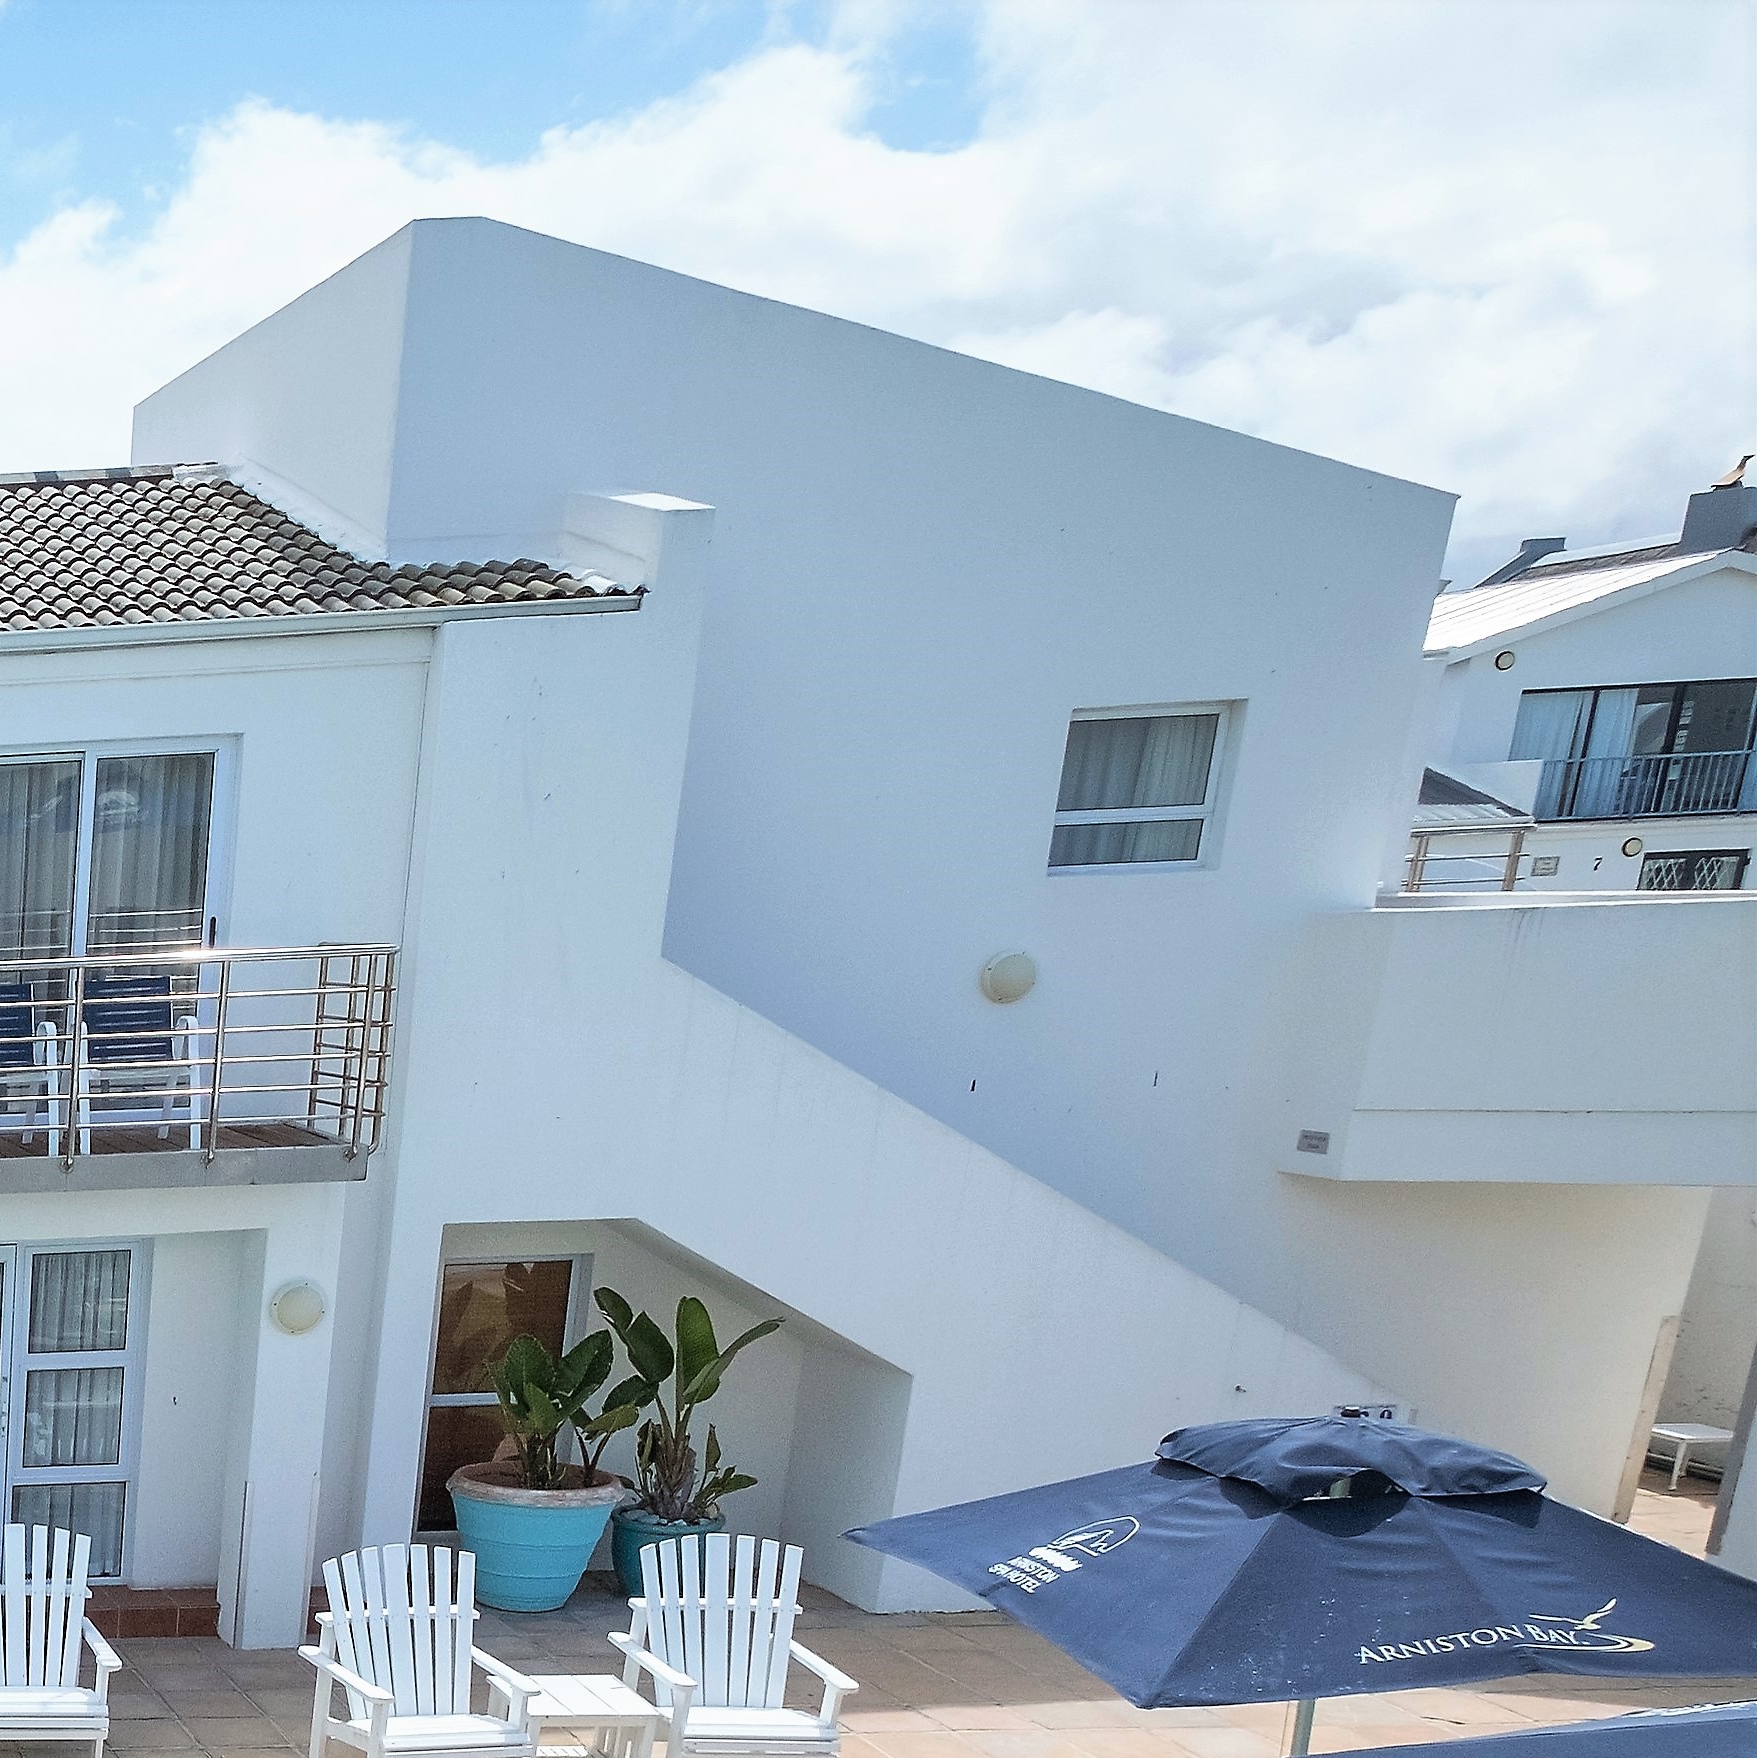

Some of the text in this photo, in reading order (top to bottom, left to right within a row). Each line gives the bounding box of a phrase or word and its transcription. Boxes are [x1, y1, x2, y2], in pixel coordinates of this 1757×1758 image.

[1593, 857, 1603, 871] 7
[1357, 1623, 1579, 1665] ARNISTON BAY
